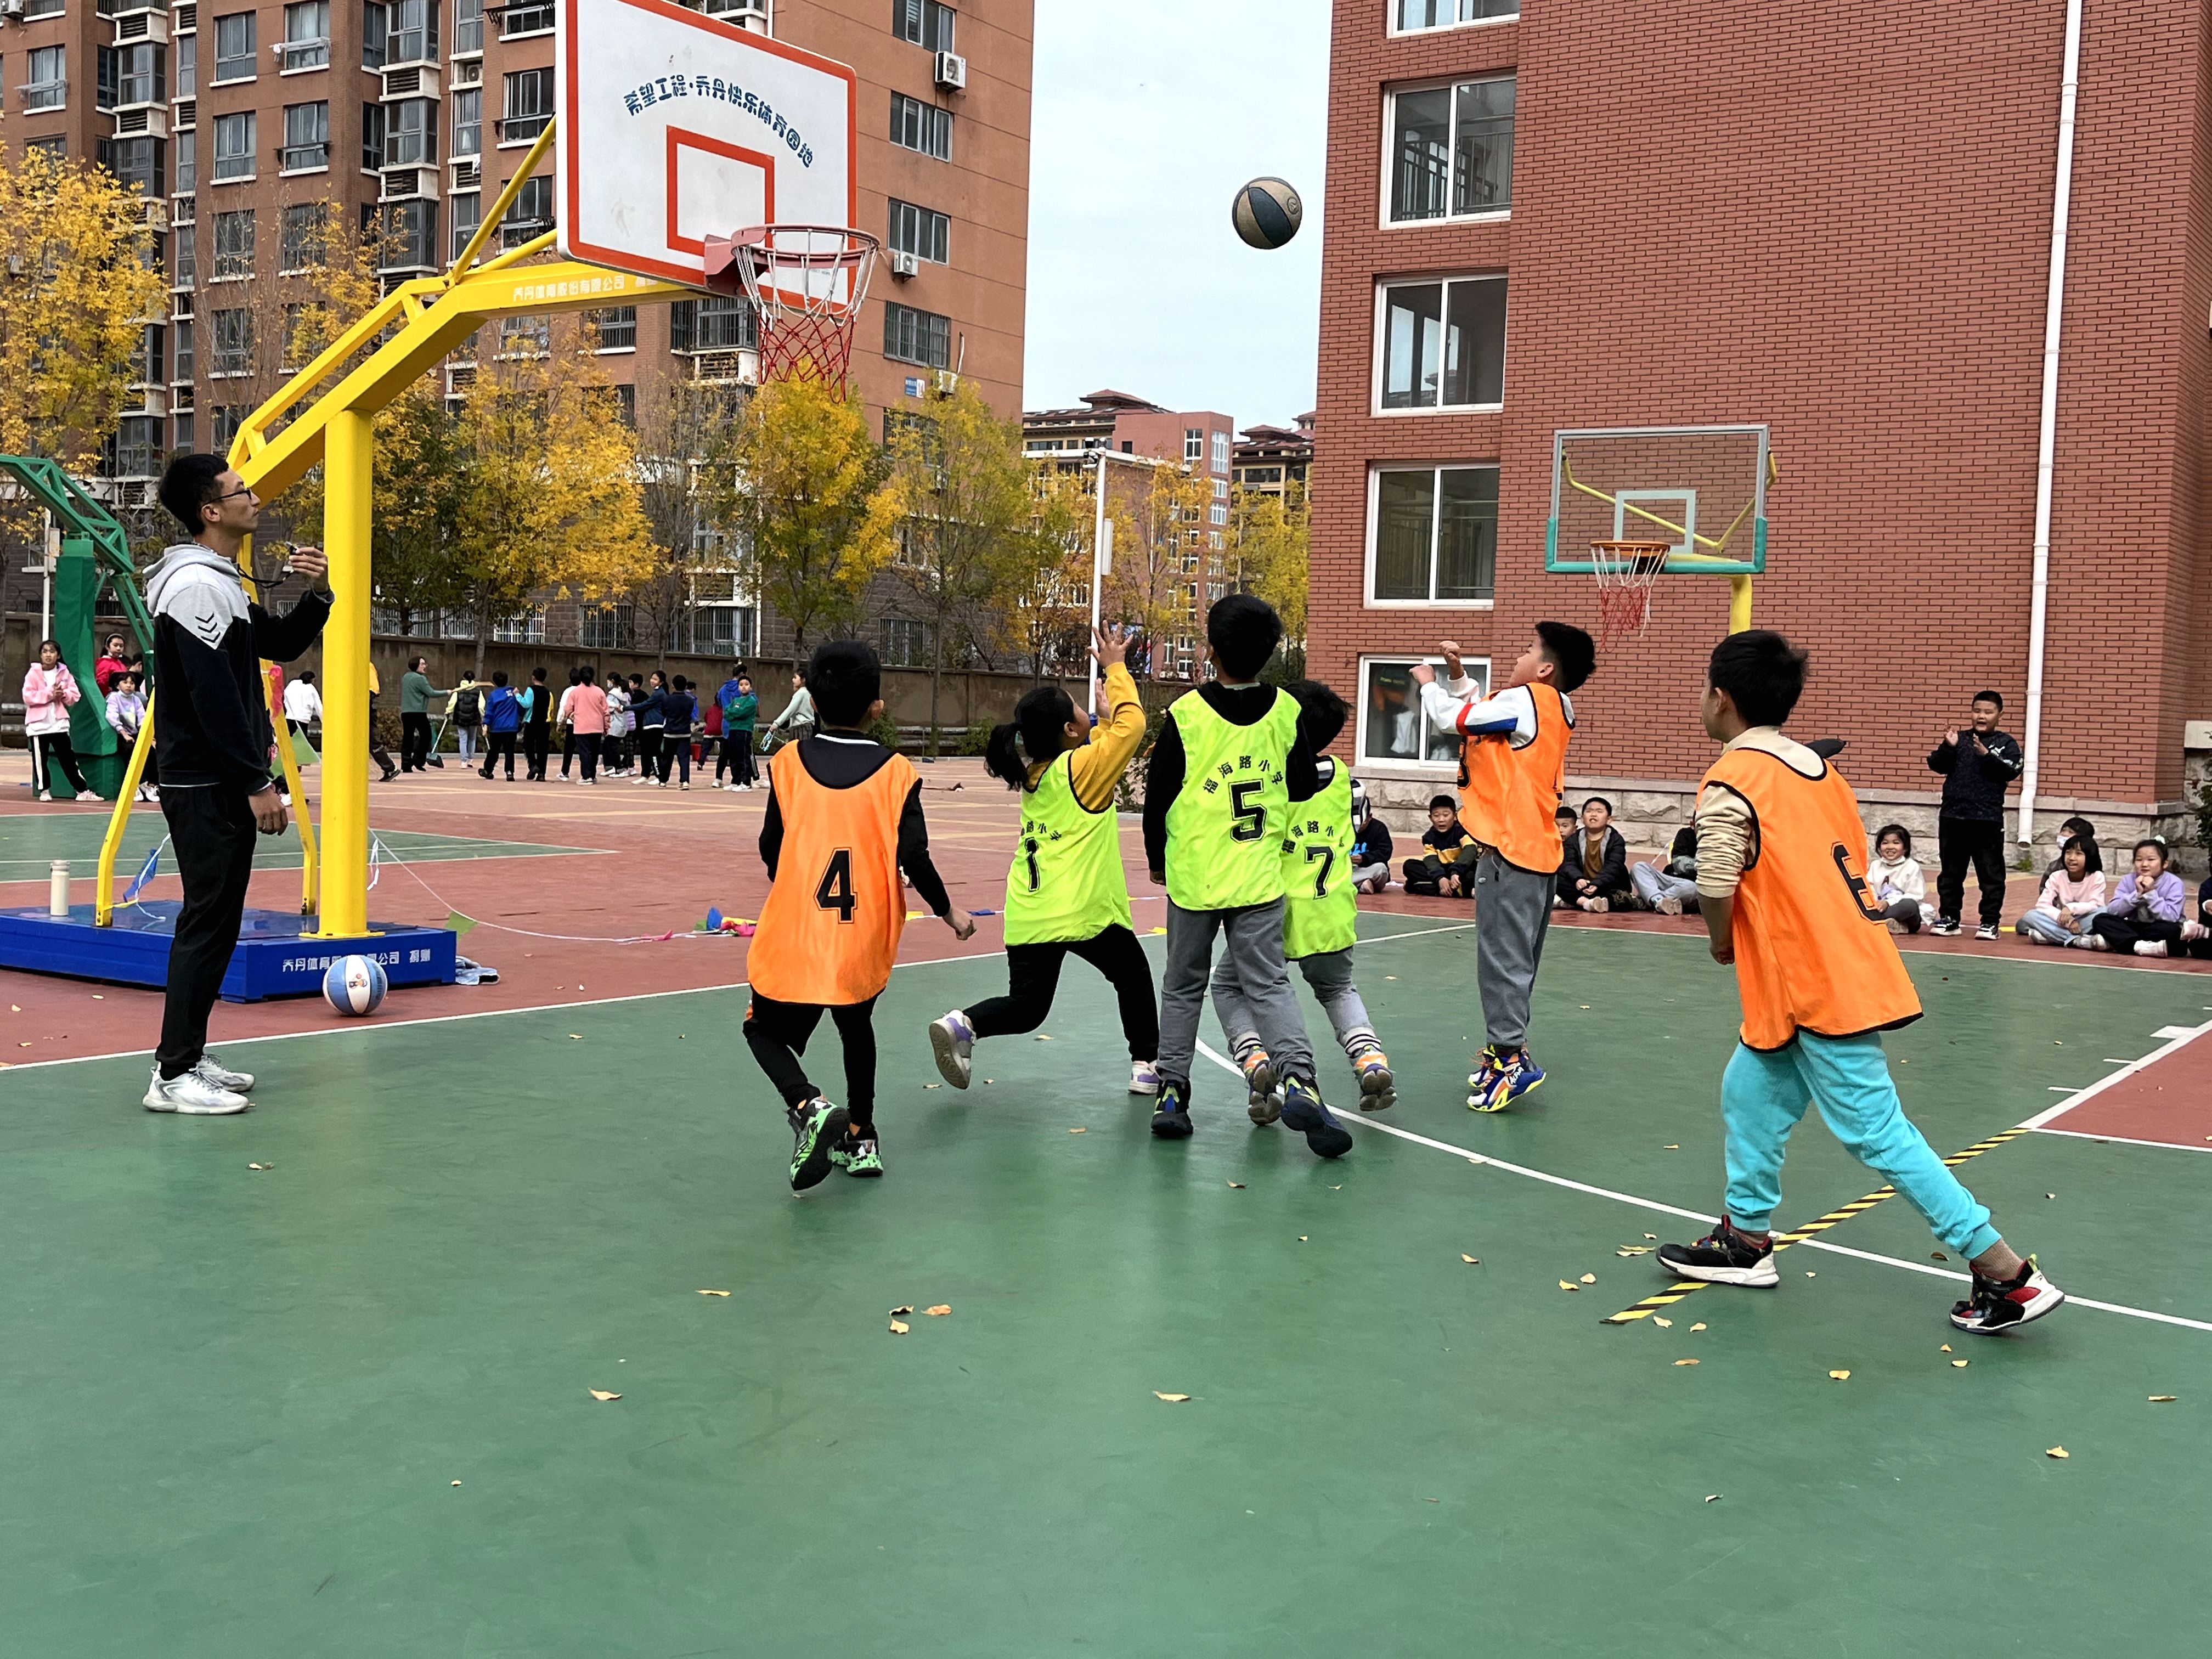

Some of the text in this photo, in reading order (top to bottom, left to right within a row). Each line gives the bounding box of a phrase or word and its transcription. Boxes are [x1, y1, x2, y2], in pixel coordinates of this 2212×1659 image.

[1228, 778, 1267, 844] 5
[813, 847, 858, 924] 4
[1024, 837, 1040, 892] 1
[1304, 845, 1335, 900] 7
